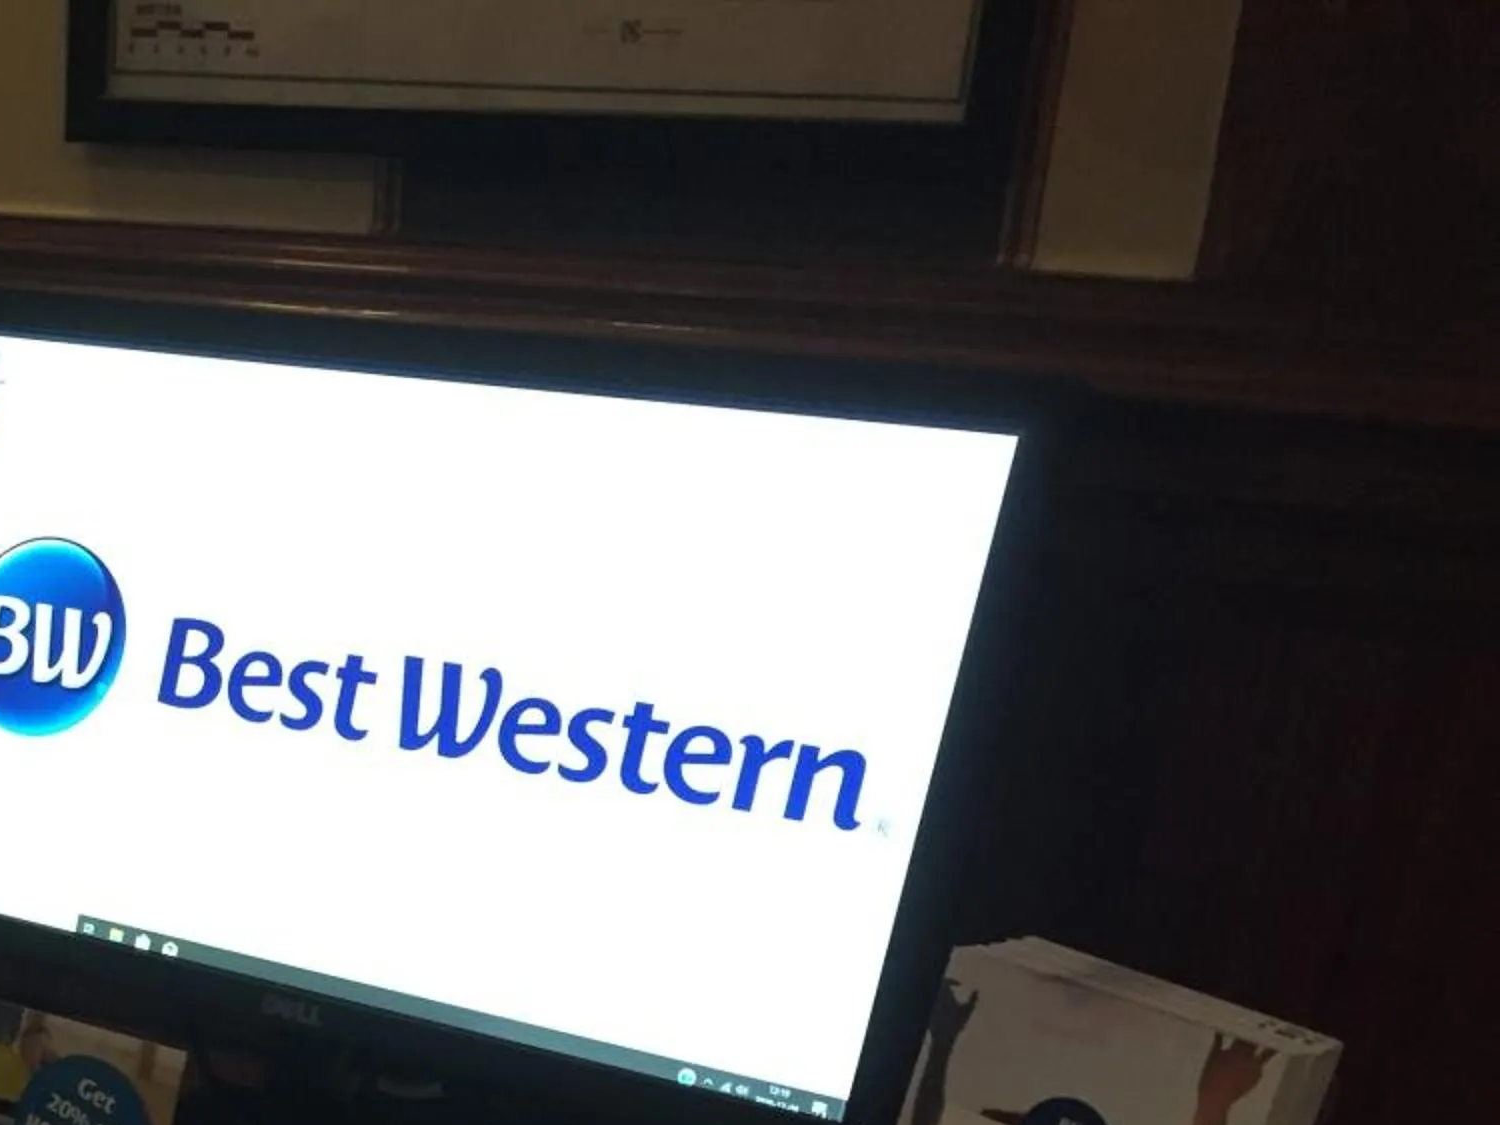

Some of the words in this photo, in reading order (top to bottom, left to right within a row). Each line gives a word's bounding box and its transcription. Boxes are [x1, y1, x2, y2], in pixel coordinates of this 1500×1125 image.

[157, 617, 378, 742] Best
[399, 655, 868, 831] Western
[76, 1077, 117, 1115] Get
